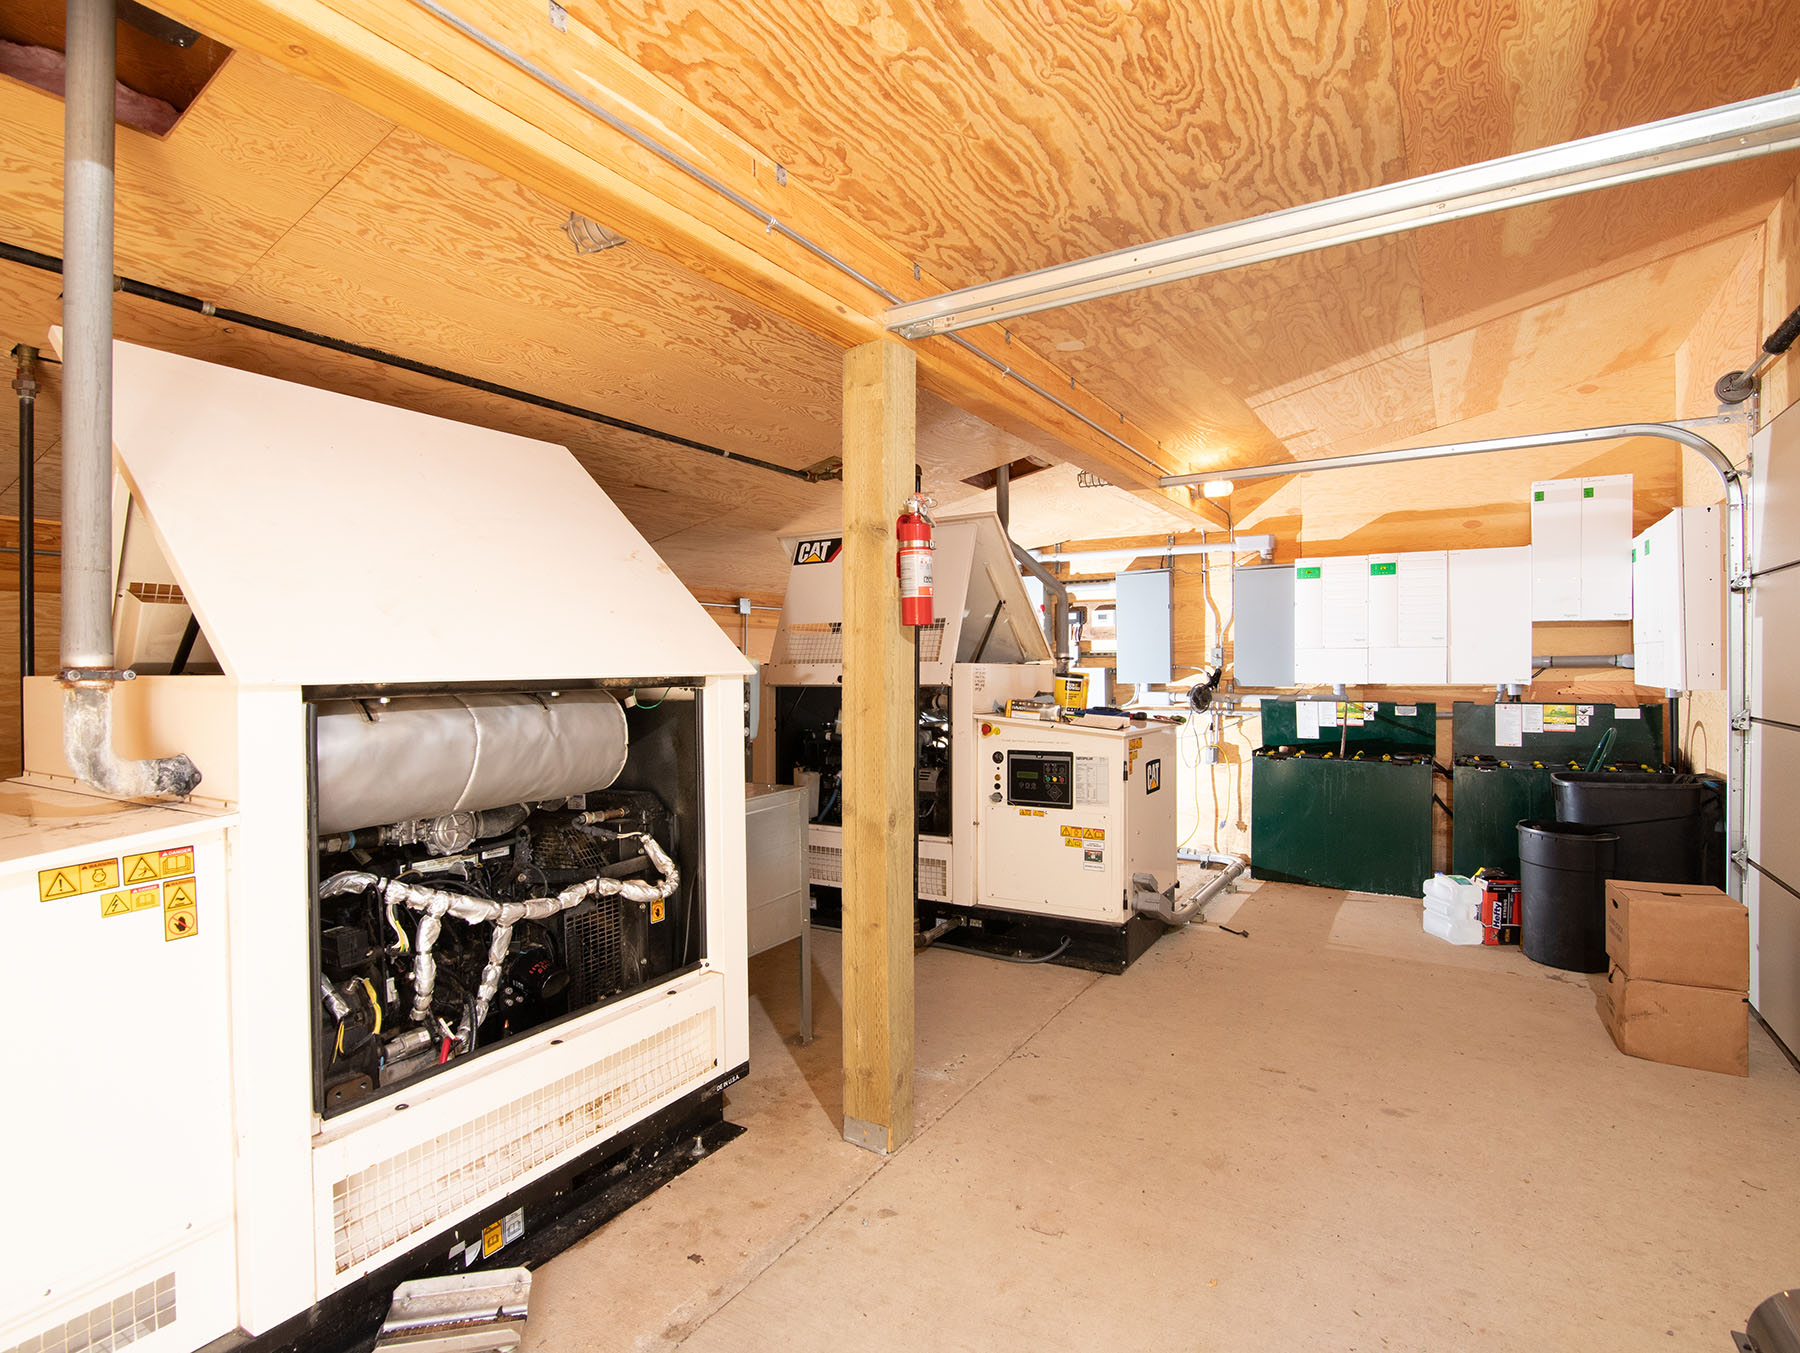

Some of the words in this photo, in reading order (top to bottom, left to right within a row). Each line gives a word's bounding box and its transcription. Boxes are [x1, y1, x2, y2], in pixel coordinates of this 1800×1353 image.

[798, 540, 831, 563] CAT
[1147, 762, 1160, 791] CAT
[168, 847, 192, 856] DANGER
[88, 860, 116, 869] WARNING
[138, 885, 158, 893] DANGER
[1493, 902, 1502, 928] Hefty
